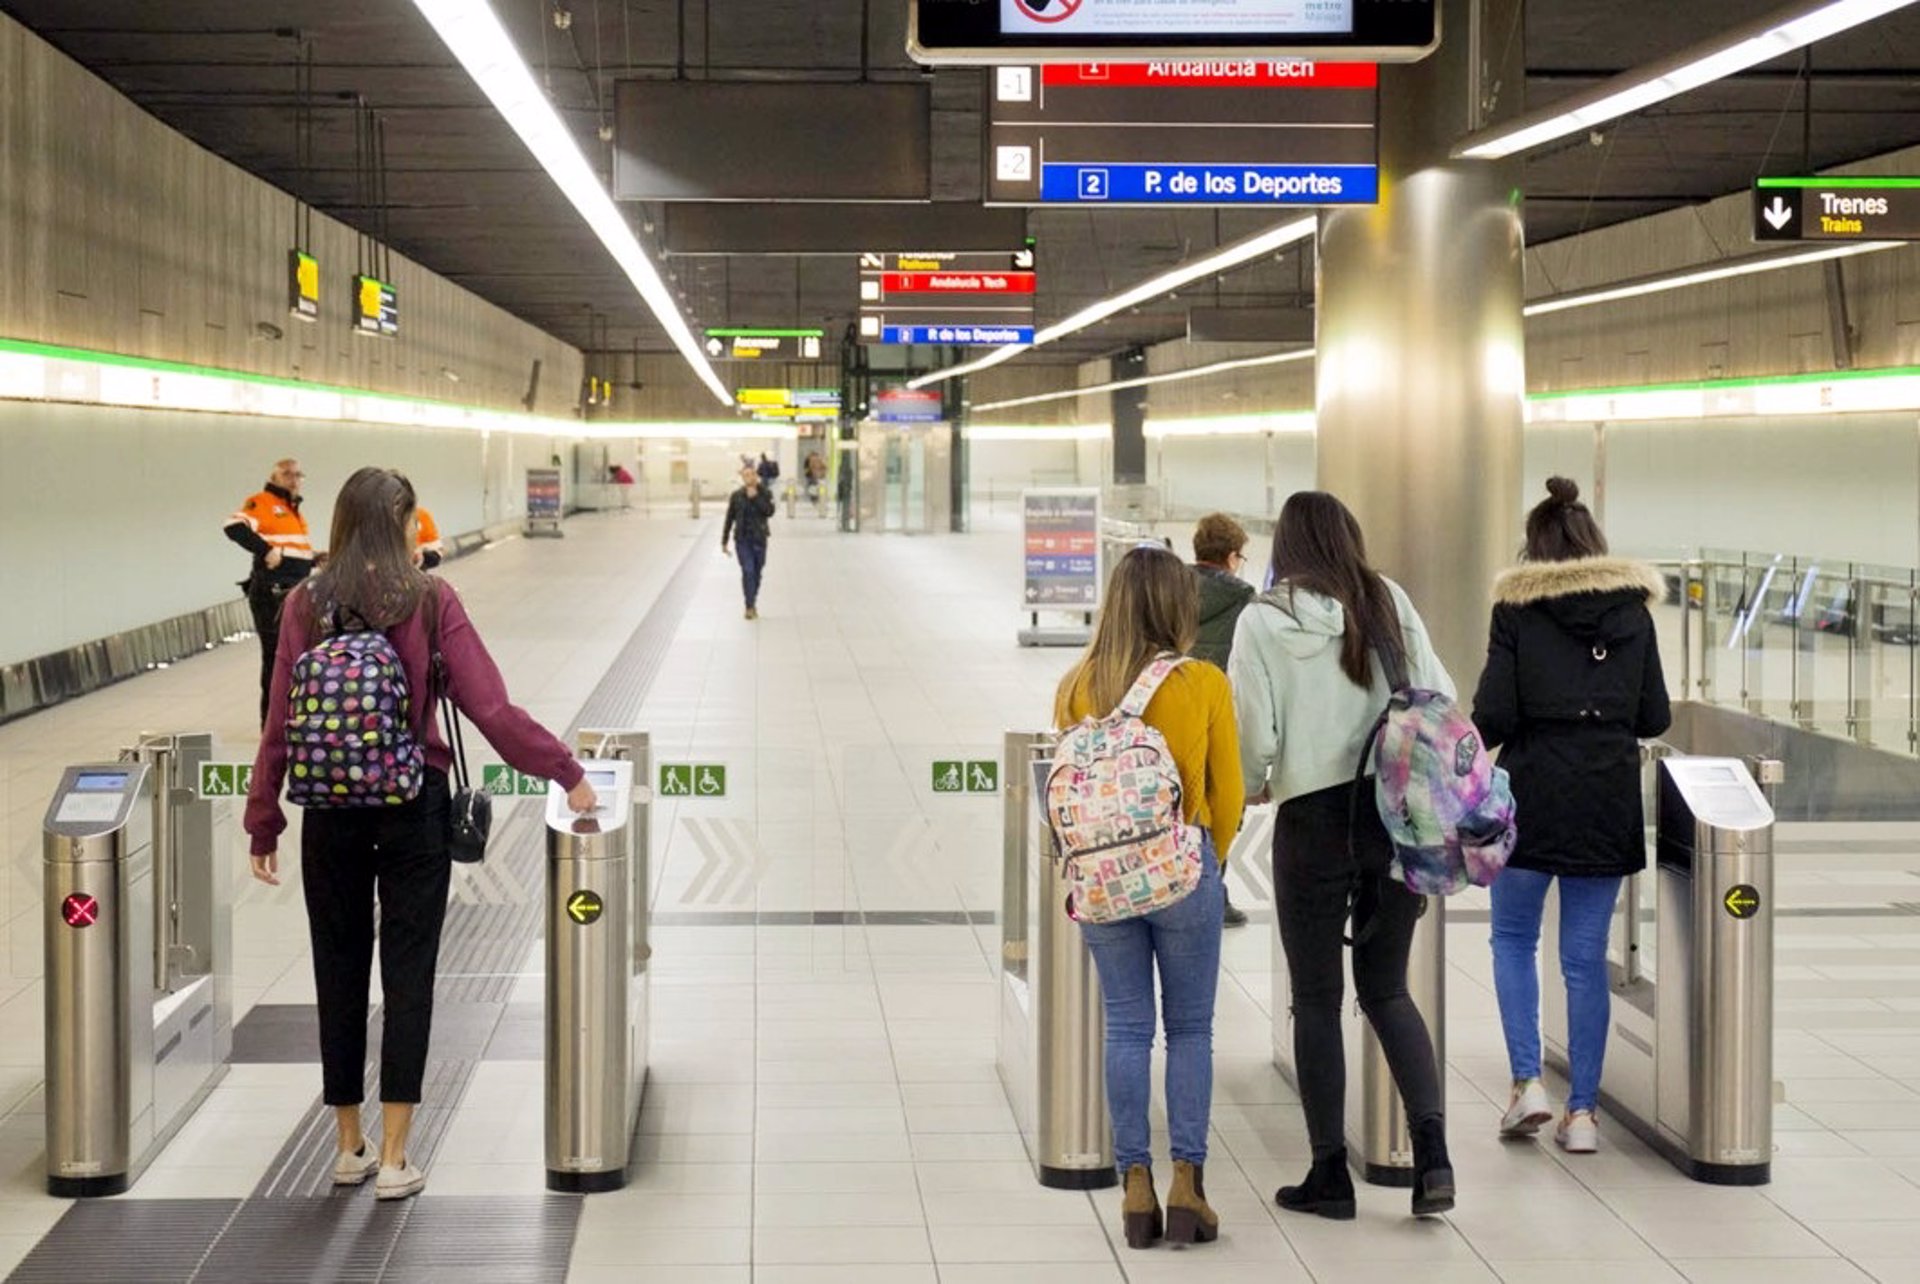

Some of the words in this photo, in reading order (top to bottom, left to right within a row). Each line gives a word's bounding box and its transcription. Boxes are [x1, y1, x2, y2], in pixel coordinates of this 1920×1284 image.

[1086, 175, 1101, 194] 2
[1144, 171, 1163, 194] P.
[1169, 171, 1199, 194] de
[1205, 171, 1237, 194] los
[1243, 171, 1344, 199] Deportes
[1820, 193, 1889, 215] Trenes
[1820, 216, 1863, 233] Trains
[981, 276, 1008, 290] Tech
[939, 328, 955, 342] de
[955, 328, 972, 342] los
[972, 327, 1021, 343] Deportes
